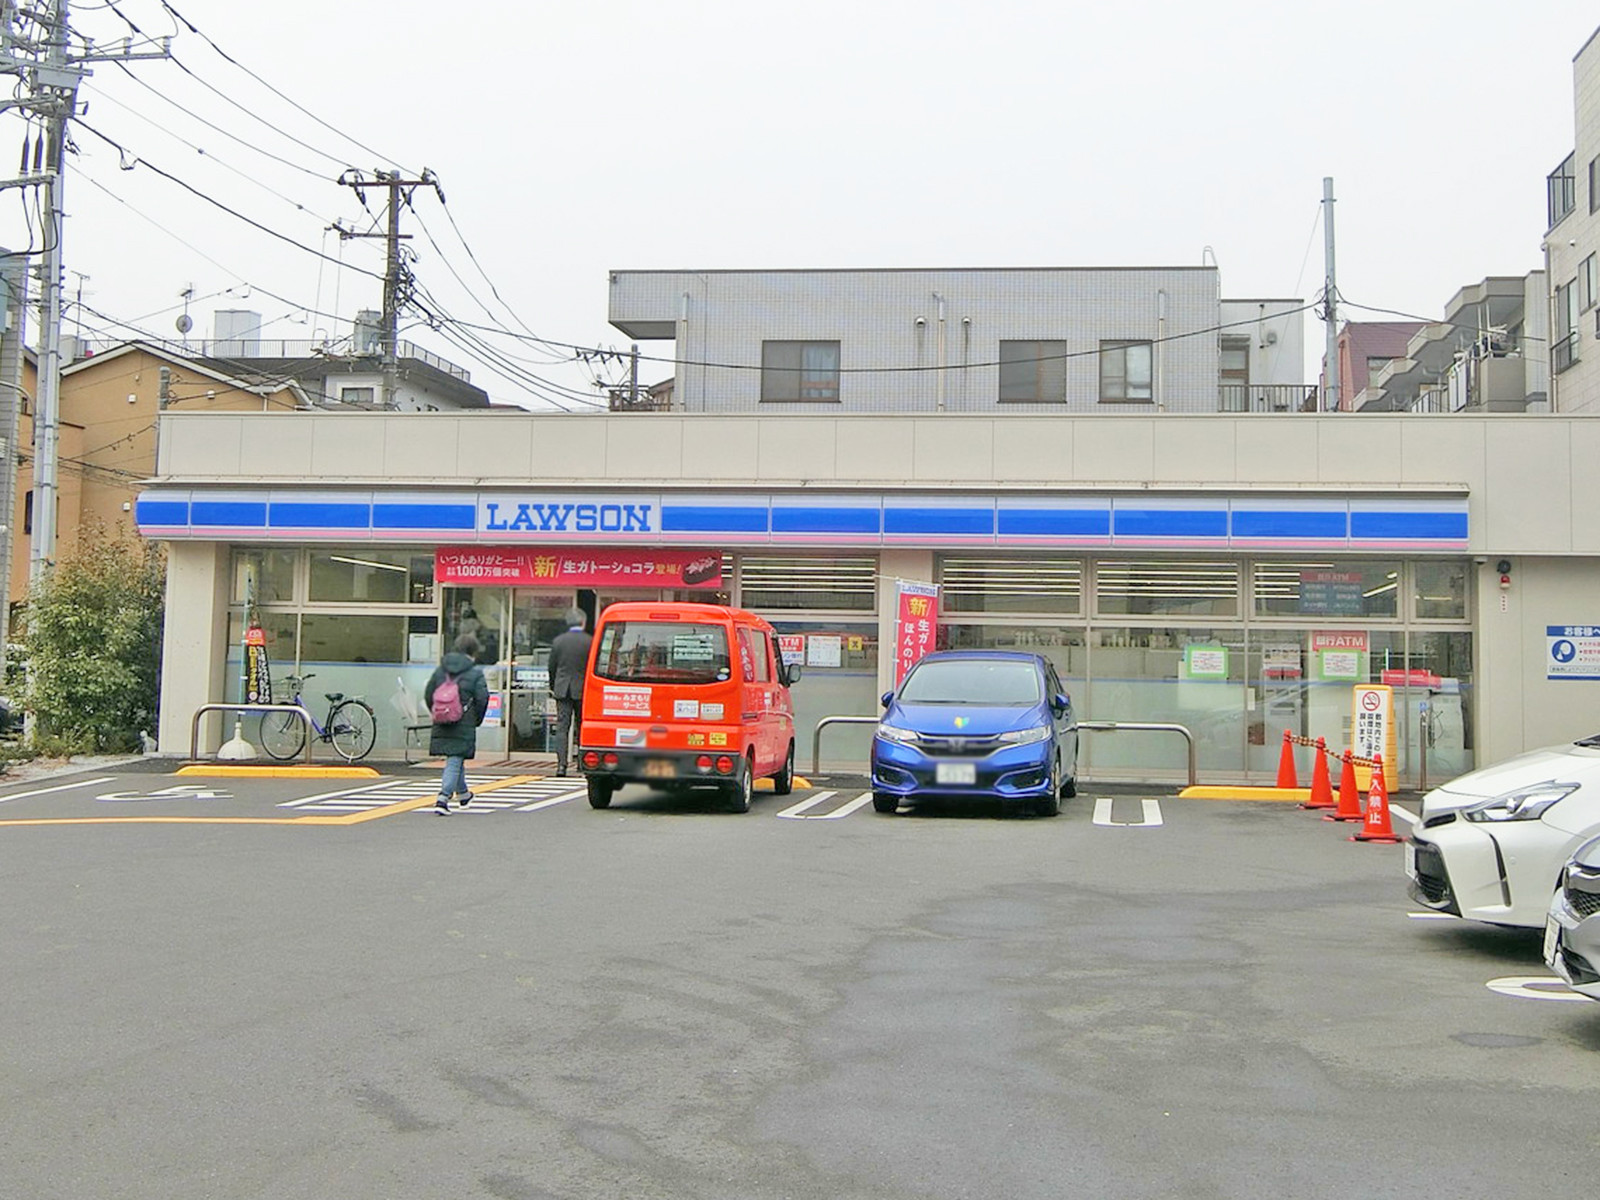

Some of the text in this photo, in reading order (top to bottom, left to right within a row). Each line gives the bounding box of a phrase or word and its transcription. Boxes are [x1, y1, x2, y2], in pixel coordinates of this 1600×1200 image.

[486, 503, 651, 532] LAWSON
[534, 554, 557, 578] 新
[909, 597, 928, 616] 新
[902, 622, 915, 679] ほんのり
[1316, 635, 1364, 646] 銀行ATM
[1369, 763, 1383, 825] 立入禁止
